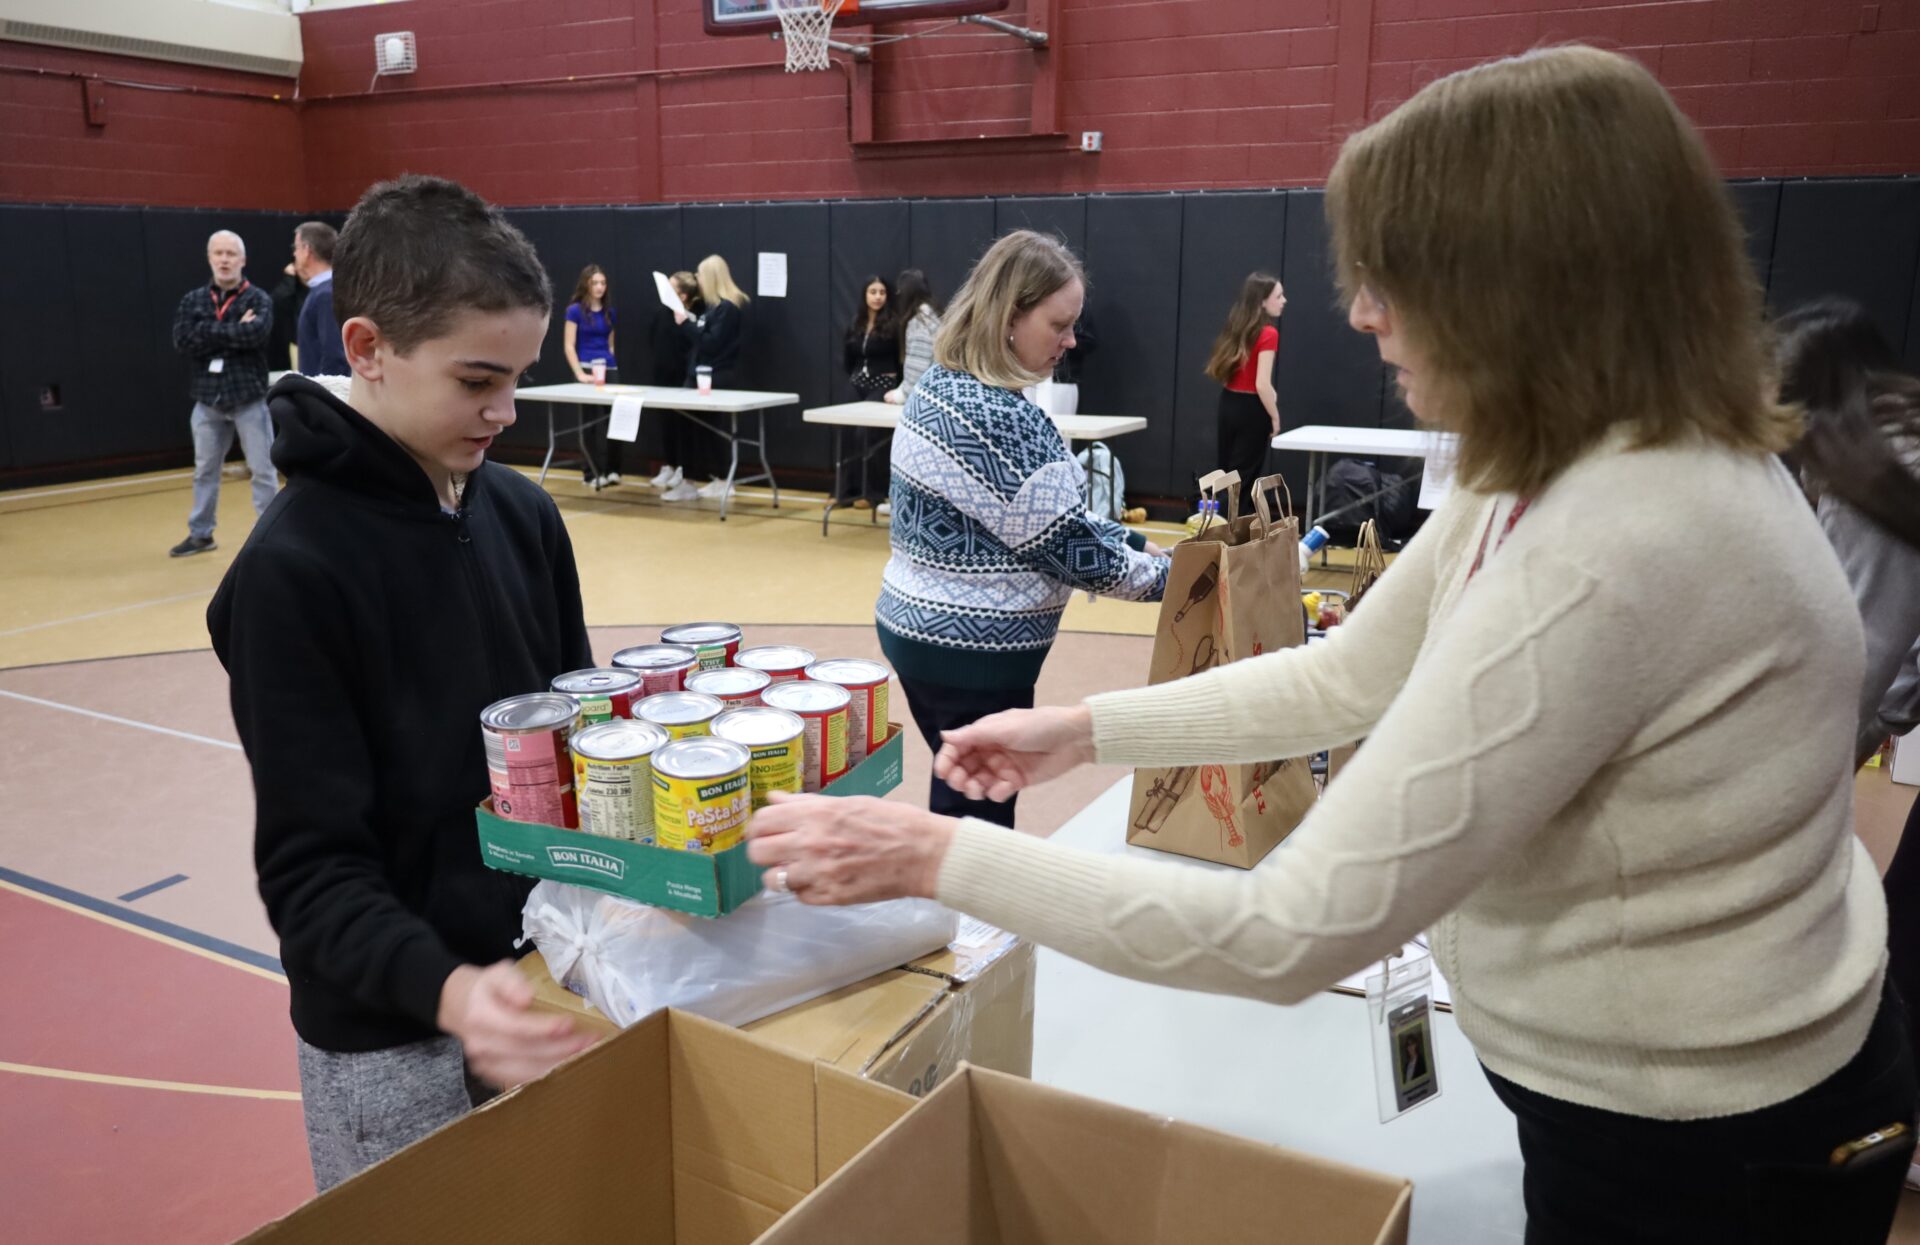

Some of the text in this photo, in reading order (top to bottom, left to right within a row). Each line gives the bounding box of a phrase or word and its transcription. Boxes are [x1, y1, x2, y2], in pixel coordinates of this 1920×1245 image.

[756, 765, 771, 773] NO
[700, 786, 723, 798] BON
[552, 851, 619, 873] BON ITALIA
